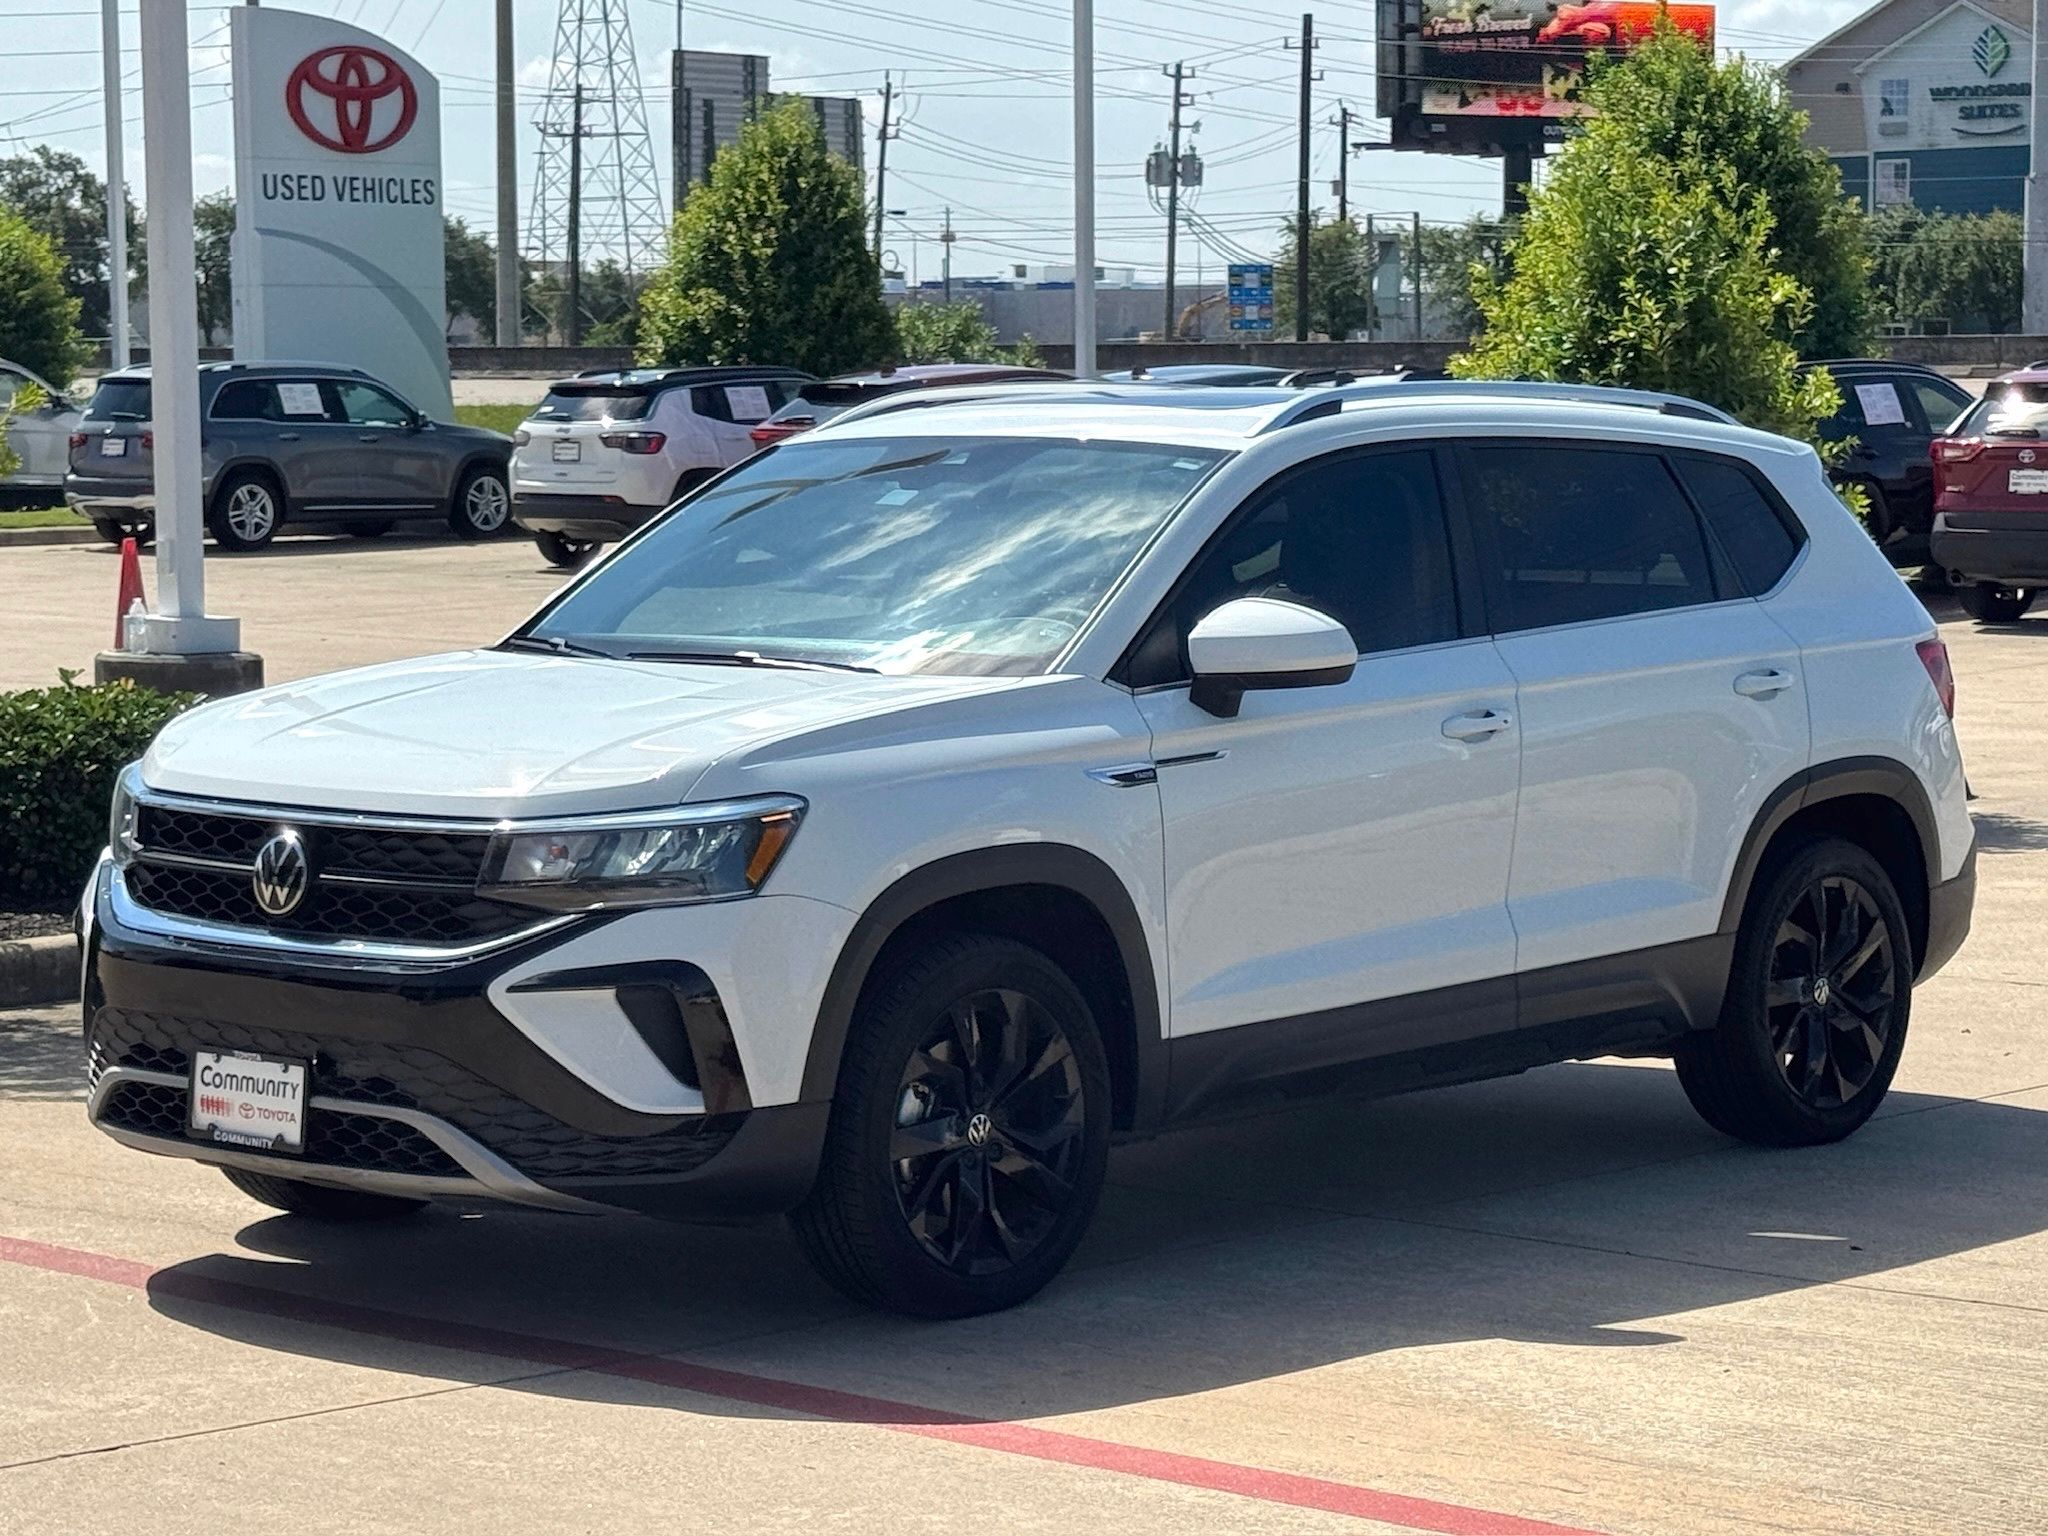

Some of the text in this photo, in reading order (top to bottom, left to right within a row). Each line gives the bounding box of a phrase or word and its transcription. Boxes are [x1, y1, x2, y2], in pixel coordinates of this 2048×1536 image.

[262, 173, 436, 206] USED VEHICLES
[256, 1107, 297, 1124] TOYOTA
[213, 1129, 273, 1150] COMMUNITY
